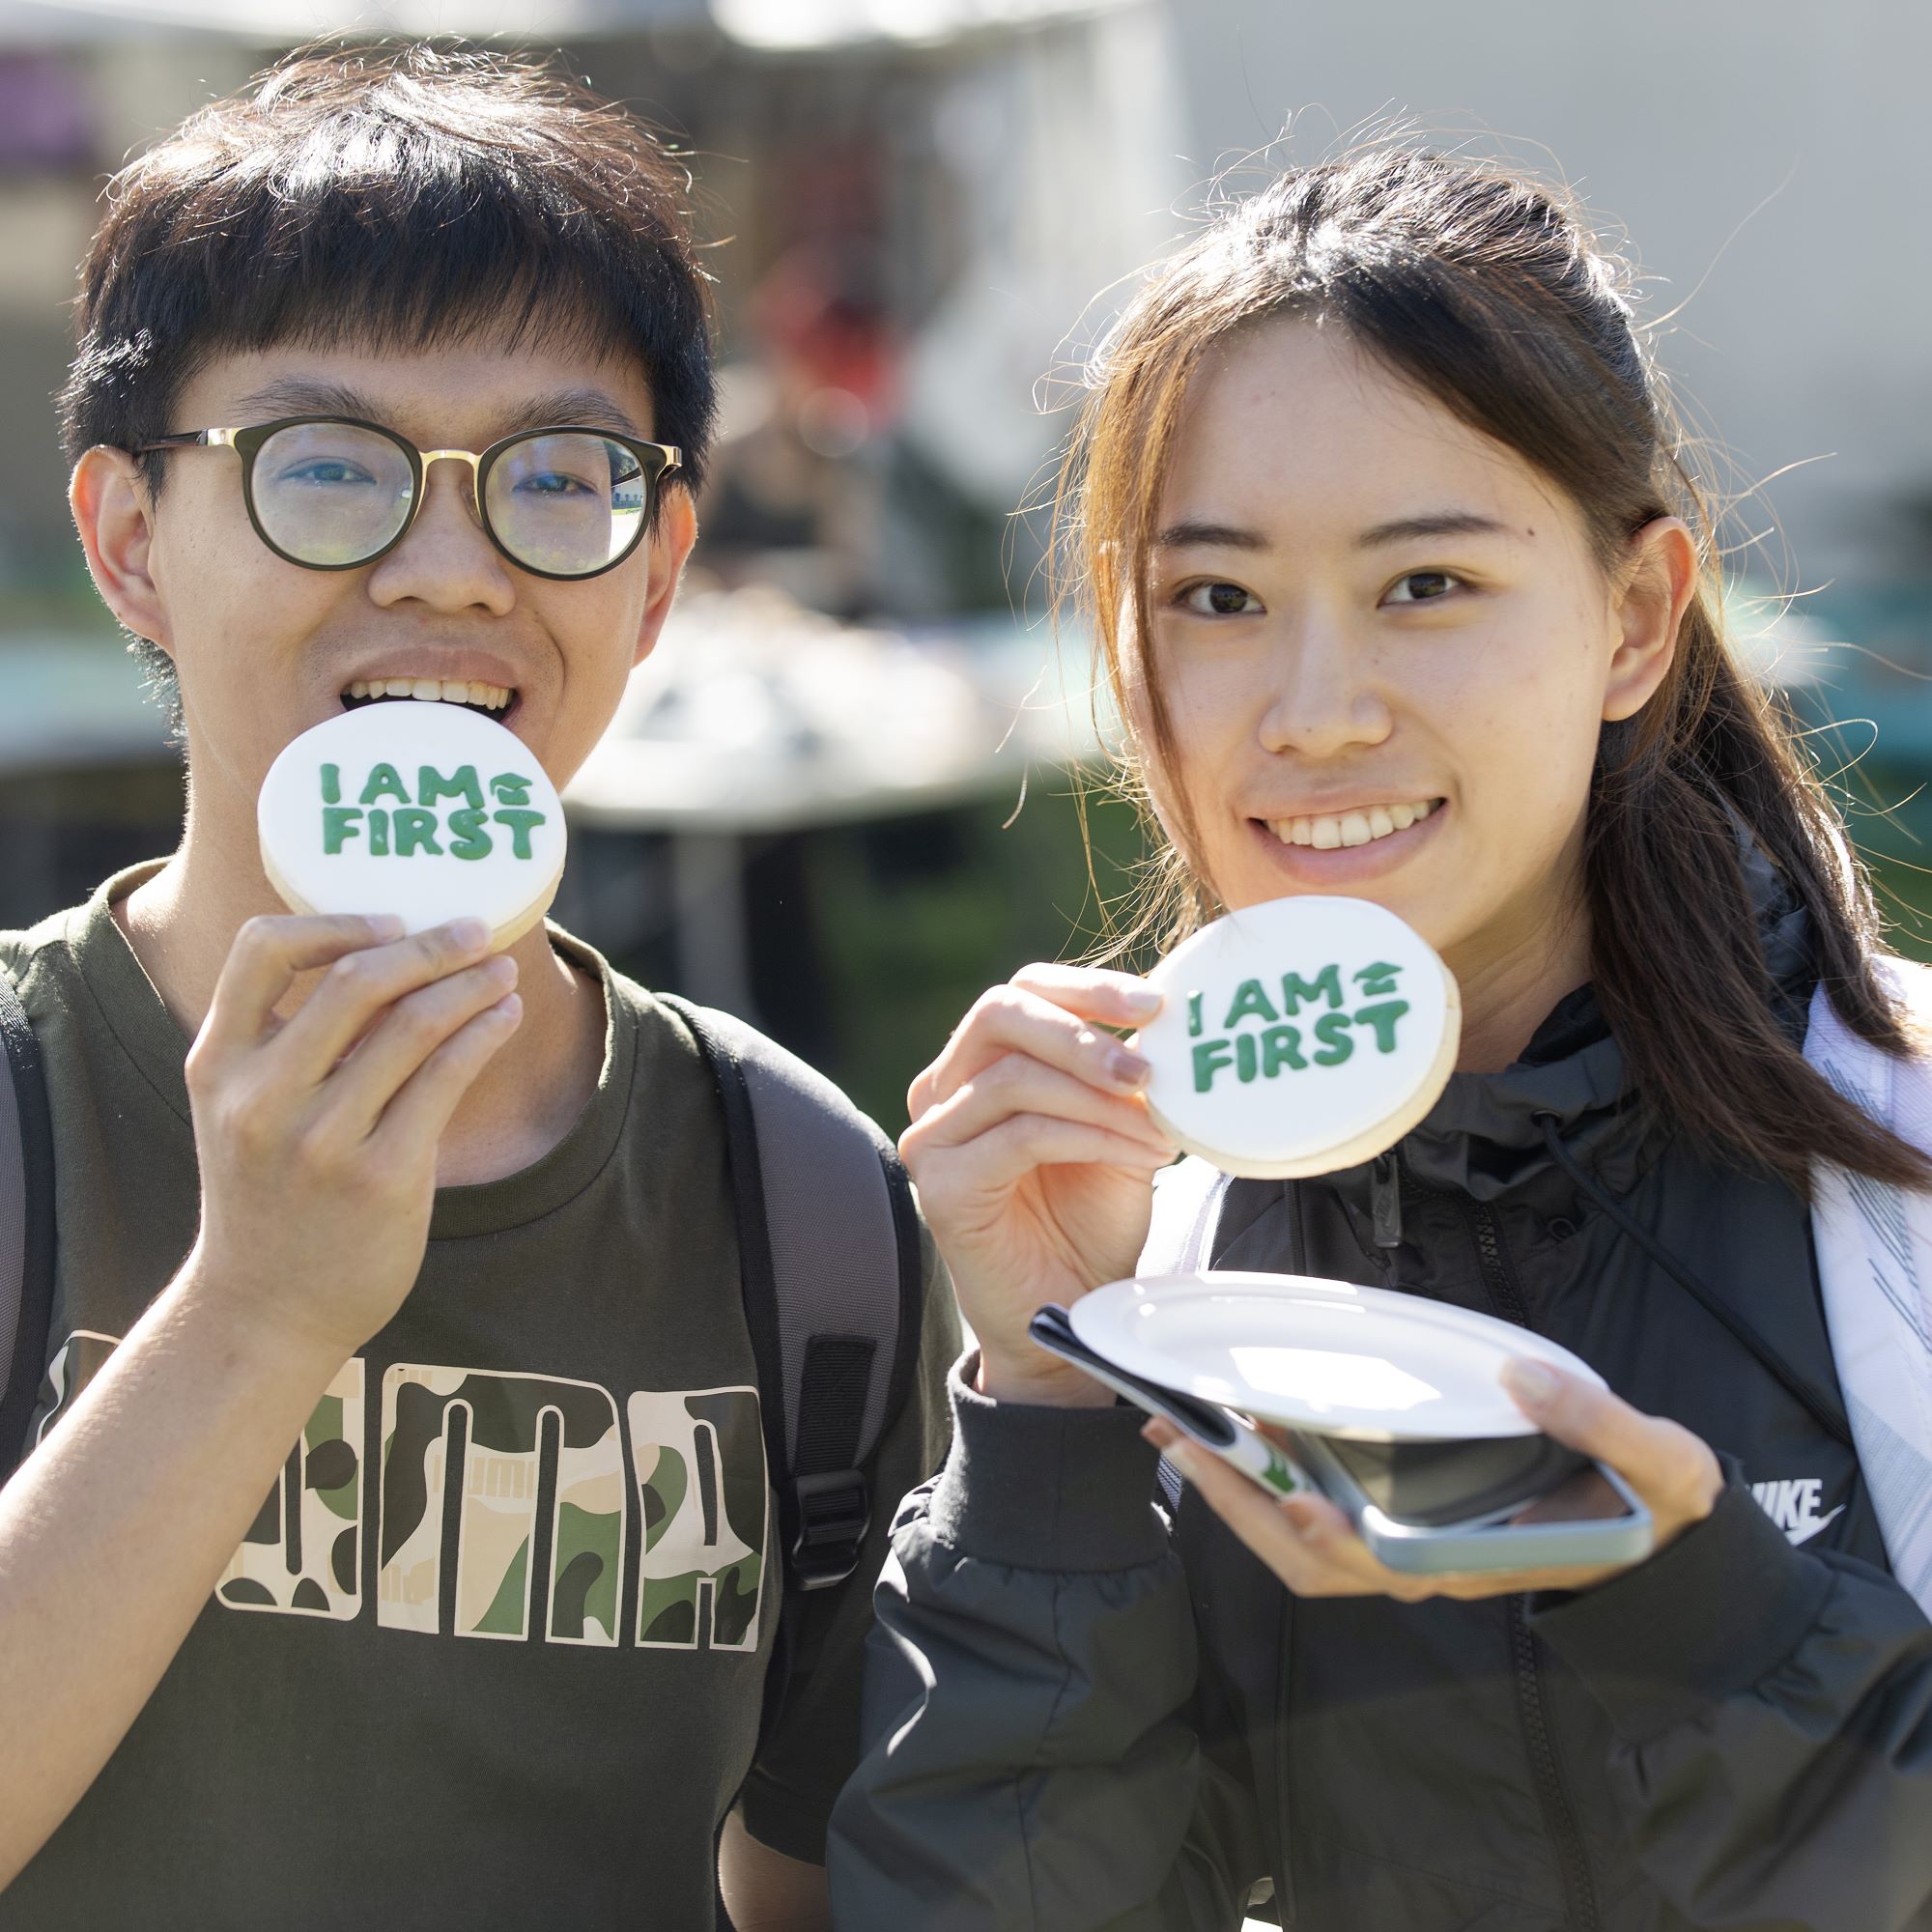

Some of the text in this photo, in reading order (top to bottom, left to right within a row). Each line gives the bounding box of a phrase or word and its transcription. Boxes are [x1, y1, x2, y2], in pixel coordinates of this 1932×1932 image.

[319, 761, 486, 810] I AM
[322, 807, 547, 861] FIRST
[1187, 963, 1345, 1037] I AM
[1191, 999, 1410, 1094] FIRST
[35, 1329, 771, 1653] UMA
